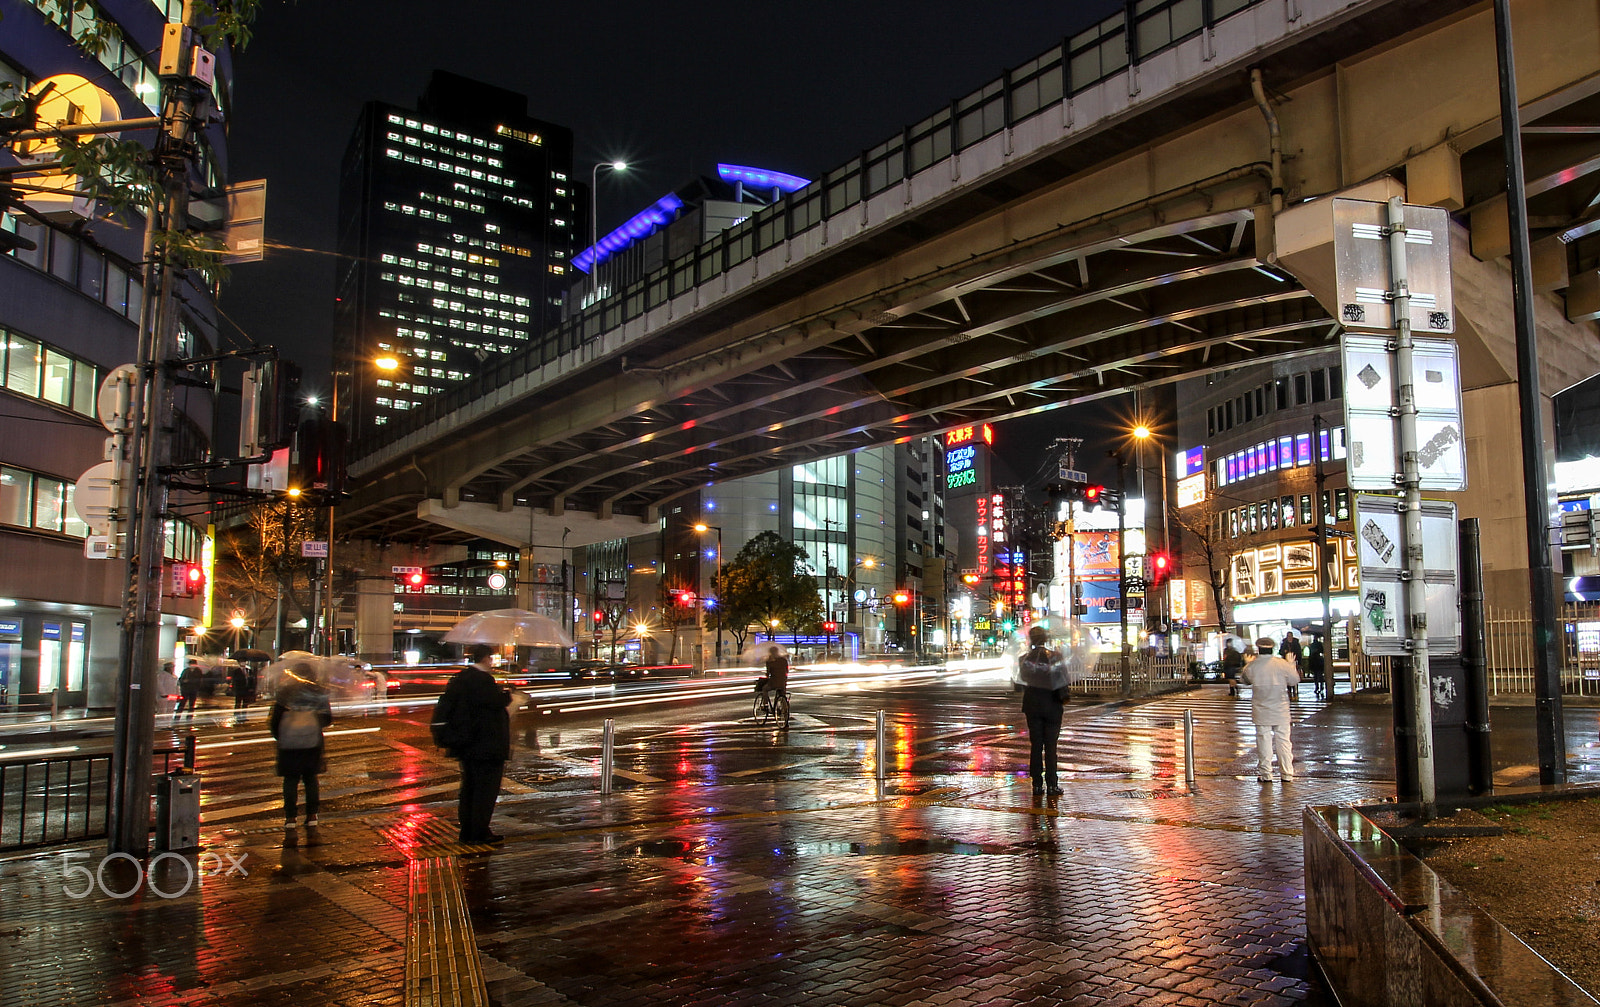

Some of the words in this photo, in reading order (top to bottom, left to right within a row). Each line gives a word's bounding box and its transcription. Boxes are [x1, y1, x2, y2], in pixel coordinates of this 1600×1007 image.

[947, 426, 974, 446] 大東洋
[1229, 443, 1308, 473] PROMISE
